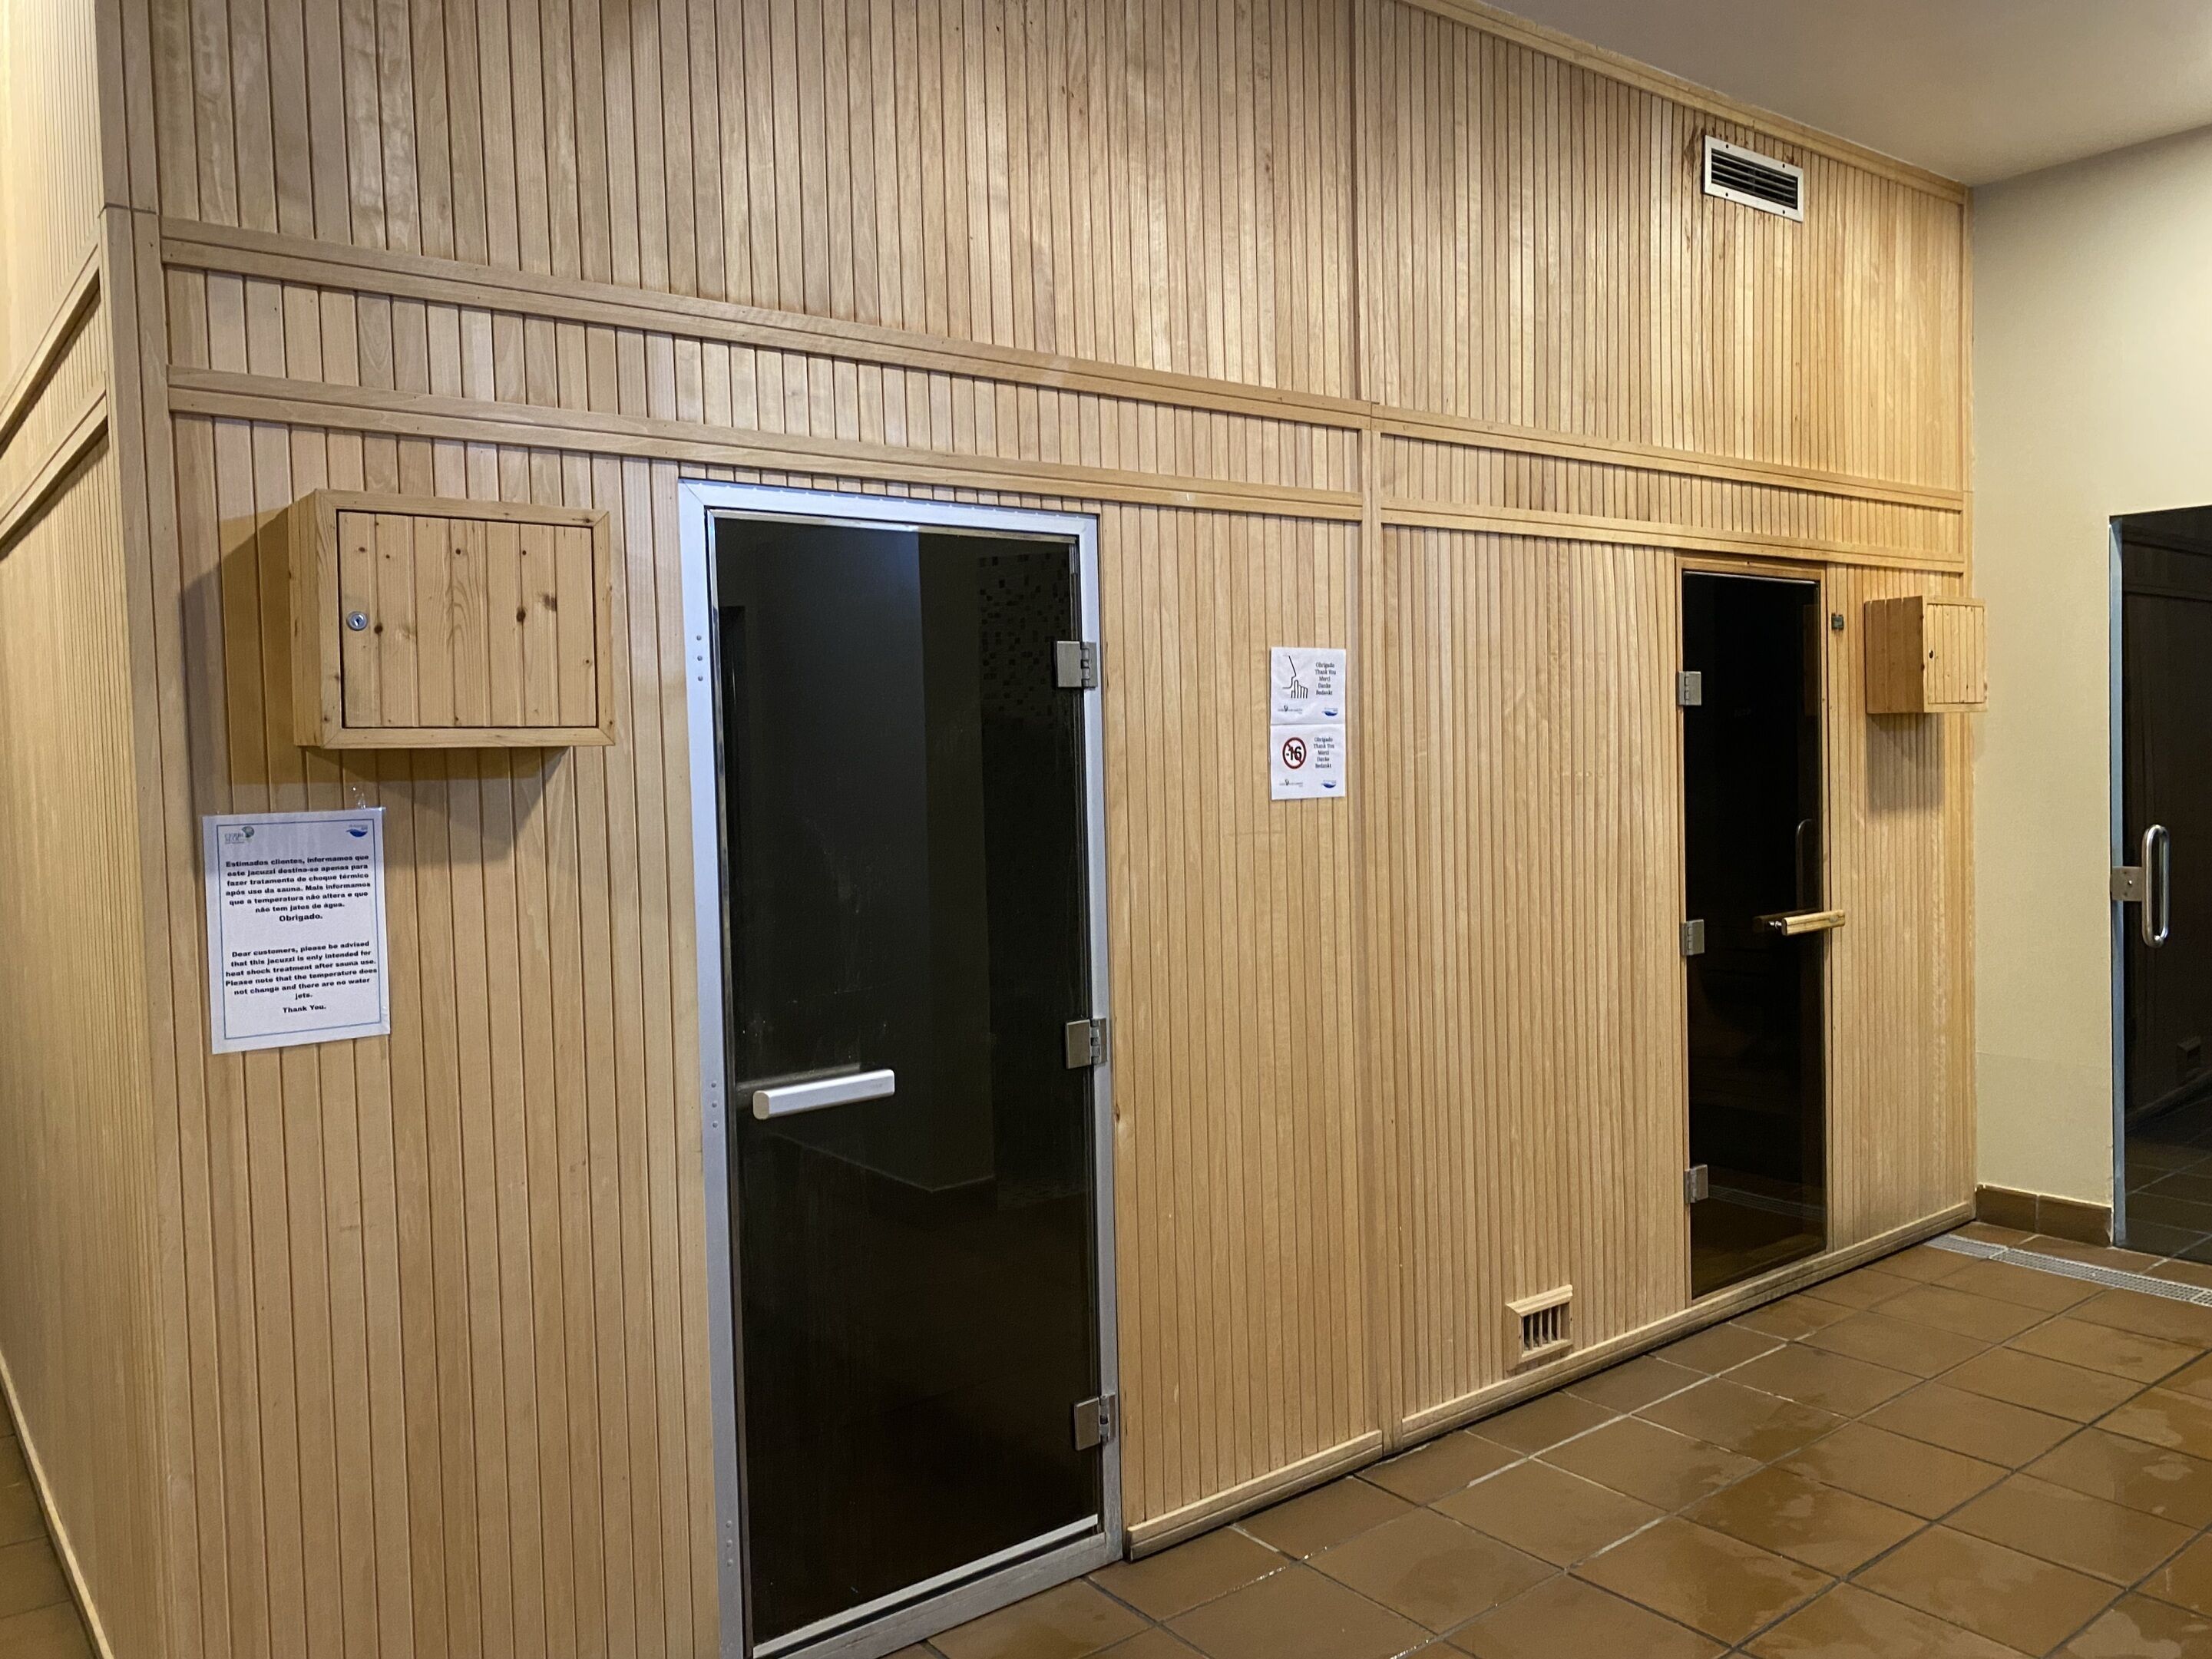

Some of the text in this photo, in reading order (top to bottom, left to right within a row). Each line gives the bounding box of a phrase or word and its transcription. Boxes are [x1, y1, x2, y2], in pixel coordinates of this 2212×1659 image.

[1286, 746, 1302, 761] -16
[247, 868, 276, 877] jacuzzi
[255, 895, 303, 904] temperatura
[253, 947, 298, 956] customers,
[301, 944, 326, 953] please
[325, 950, 358, 959] intended
[273, 964, 312, 973] treatment
[309, 969, 357, 979] temperature
